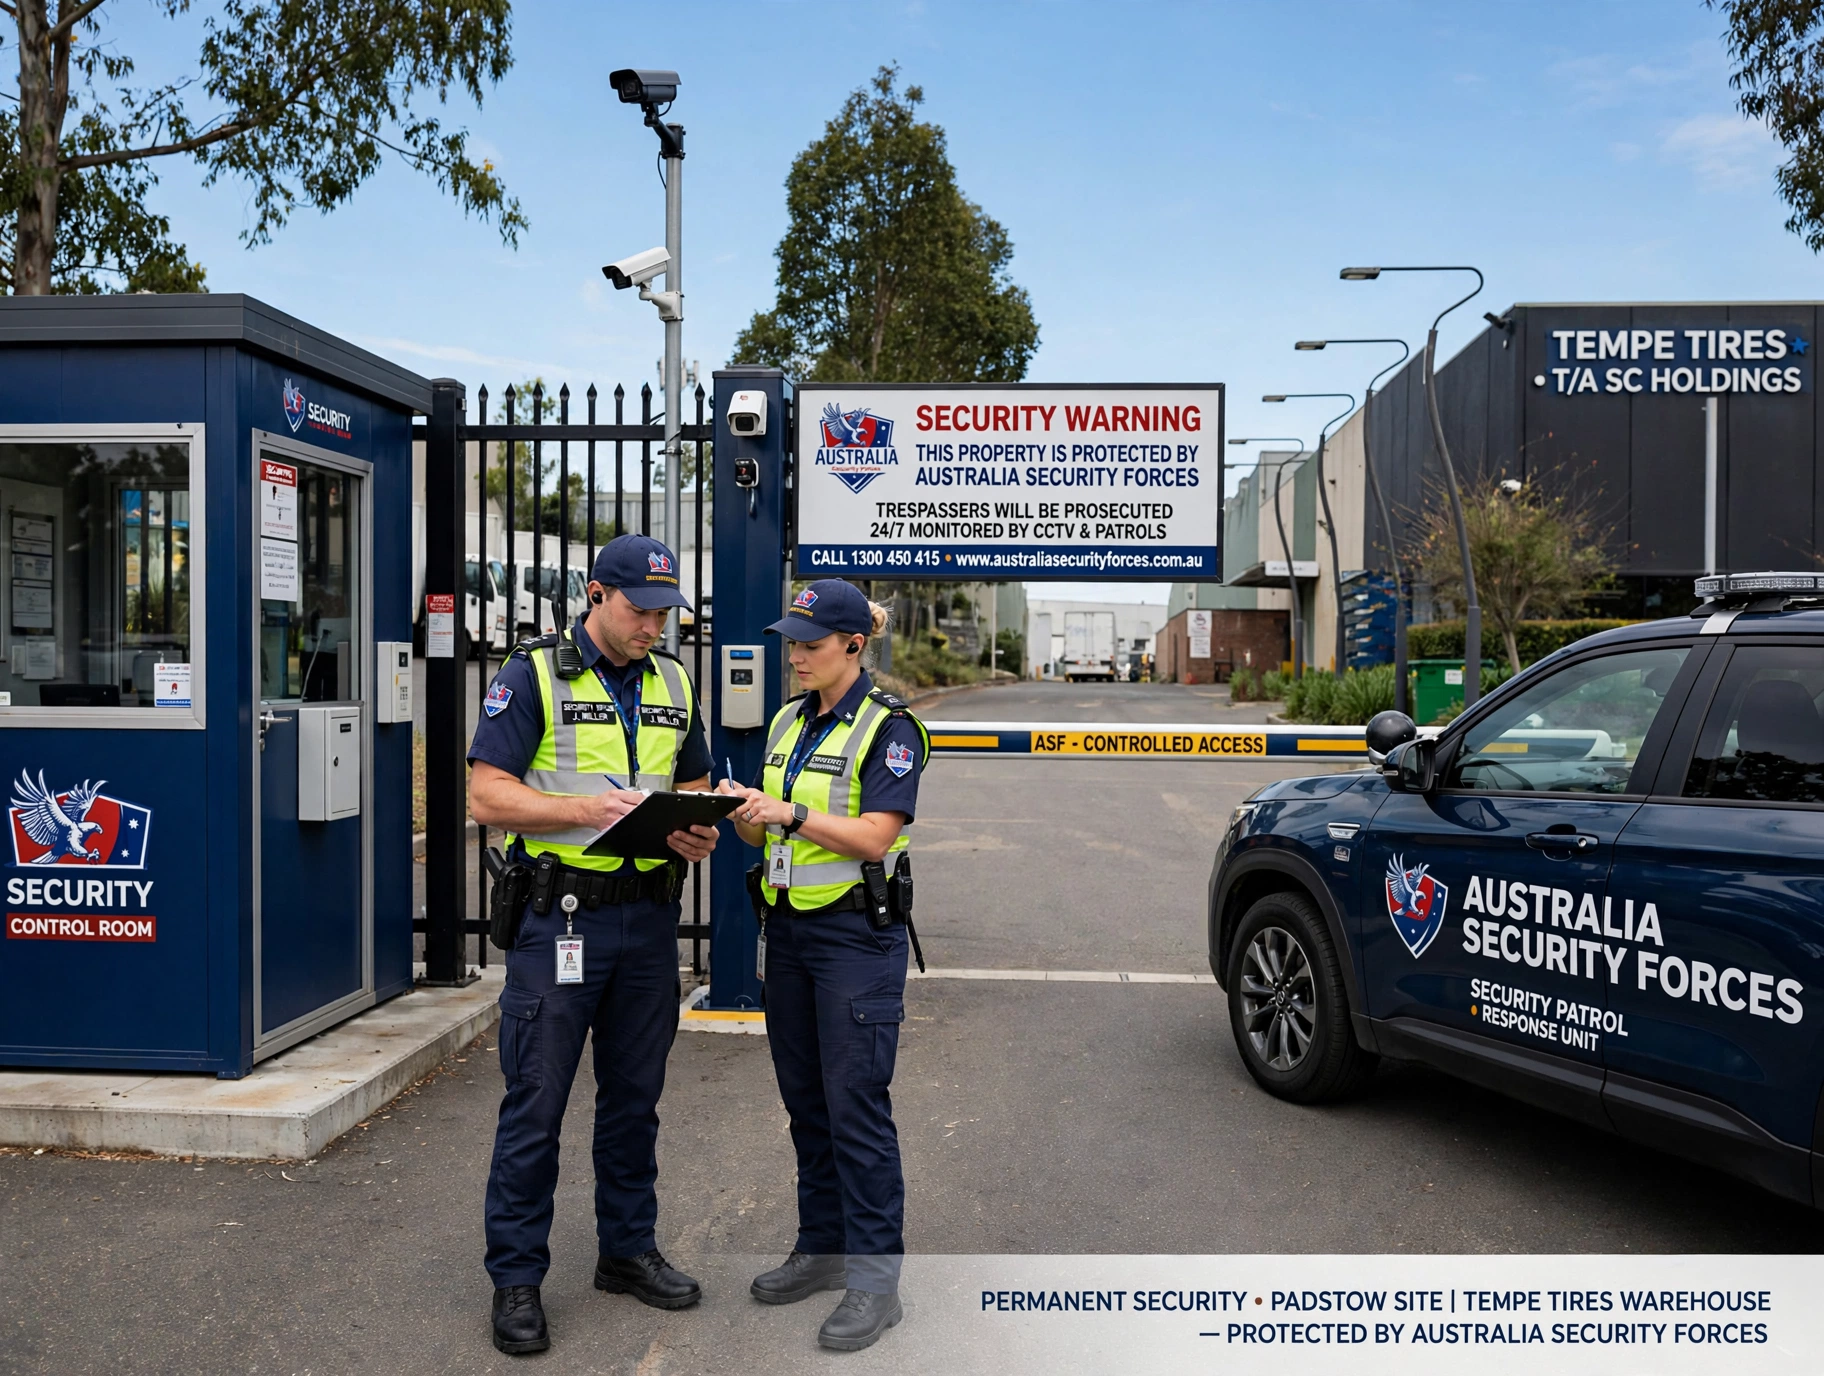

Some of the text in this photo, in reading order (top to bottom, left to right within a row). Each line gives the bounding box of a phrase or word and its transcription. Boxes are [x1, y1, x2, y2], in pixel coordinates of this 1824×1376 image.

[1553, 330, 1786, 359] TEMPE TIRES
[1552, 367, 1801, 395] T/A SC HOLDINGS
[308, 402, 350, 431] SECURITY
[916, 405, 1200, 431] SECURITY WARNING
[815, 449, 898, 465] AUSTRALIA
[916, 444, 1198, 462] THIS PROPERTY IS PROTECTED BY
[916, 467, 1199, 487] AUSTRALIA SECURITY FORCES
[876, 502, 1173, 519] TRESPASSERS WILL BE PROSECUTED
[870, 521, 1166, 539] 24/7 MONITORED BY CCTV & PATROLS
[812, 550, 1202, 570] CALL 1300 450 415 www.australiasecurityforces.com.au
[1035, 735, 1066, 751] ASF
[1084, 735, 1193, 752] CONTROLLED
[1198, 737, 1263, 753] ACCESS
[7, 878, 153, 907] SECURITY
[1463, 875, 1664, 947] AUSTRALIA
[11, 918, 151, 936] CONTROL ROOM
[1462, 918, 1804, 1025] SECURITY FORCES
[1470, 978, 1629, 1037] SECURITY PATROL
[1482, 1004, 1599, 1051] RESPONSE UNIT
